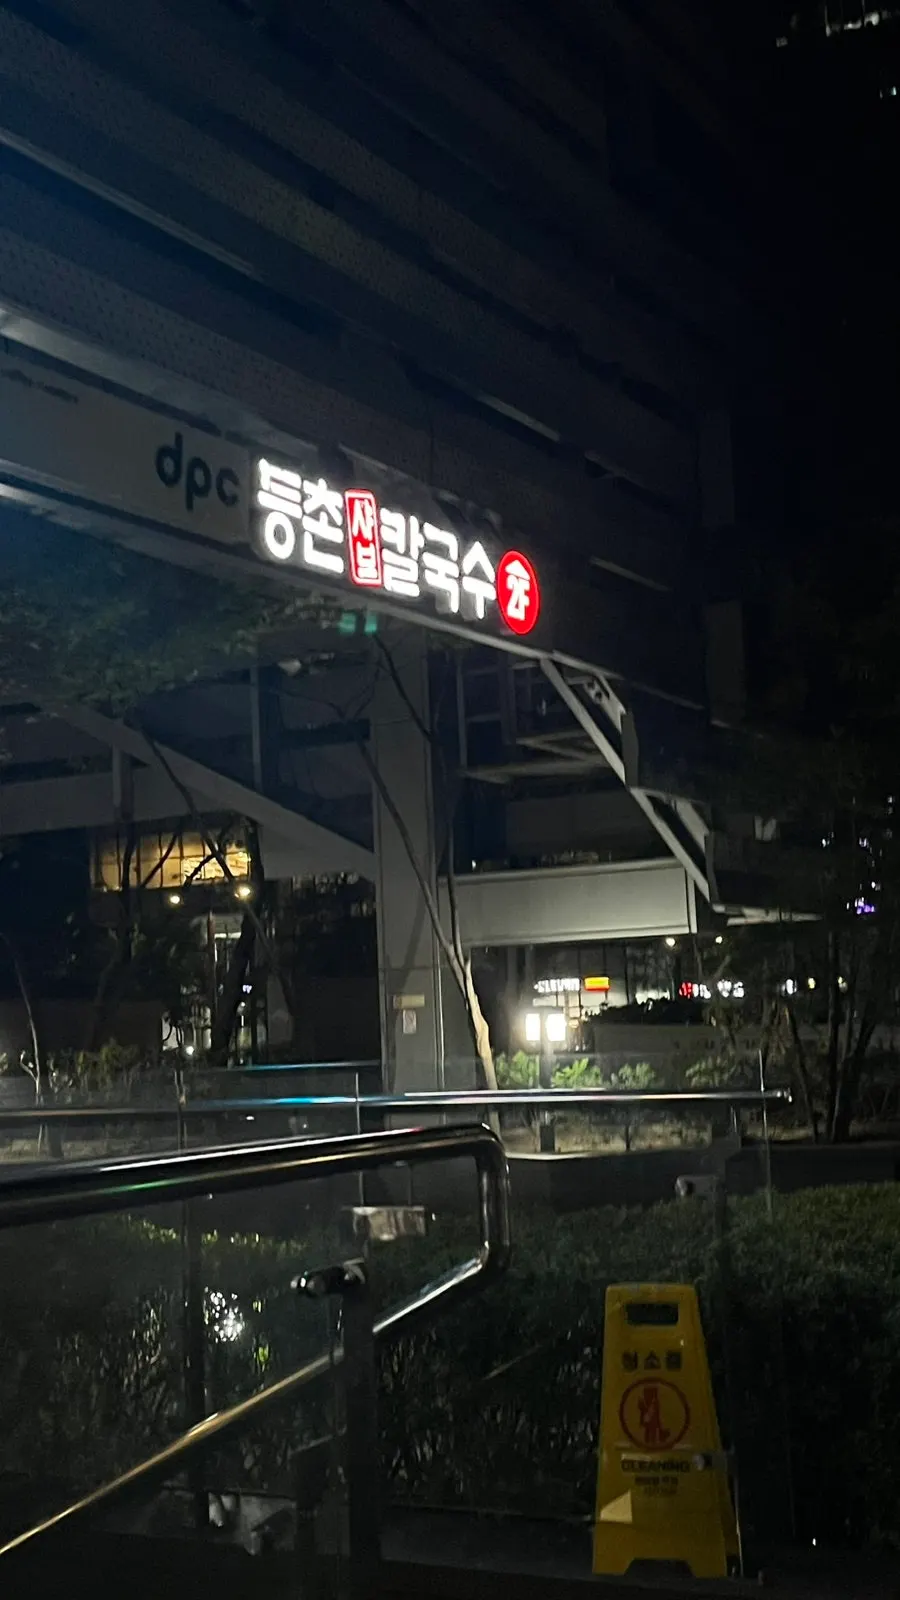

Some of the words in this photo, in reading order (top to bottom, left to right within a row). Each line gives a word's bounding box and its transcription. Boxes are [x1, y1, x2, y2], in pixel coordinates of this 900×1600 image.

[155, 431, 240, 511] dpc
[256, 457, 345, 575] 등촌
[379, 507, 497, 620] 칼국수
